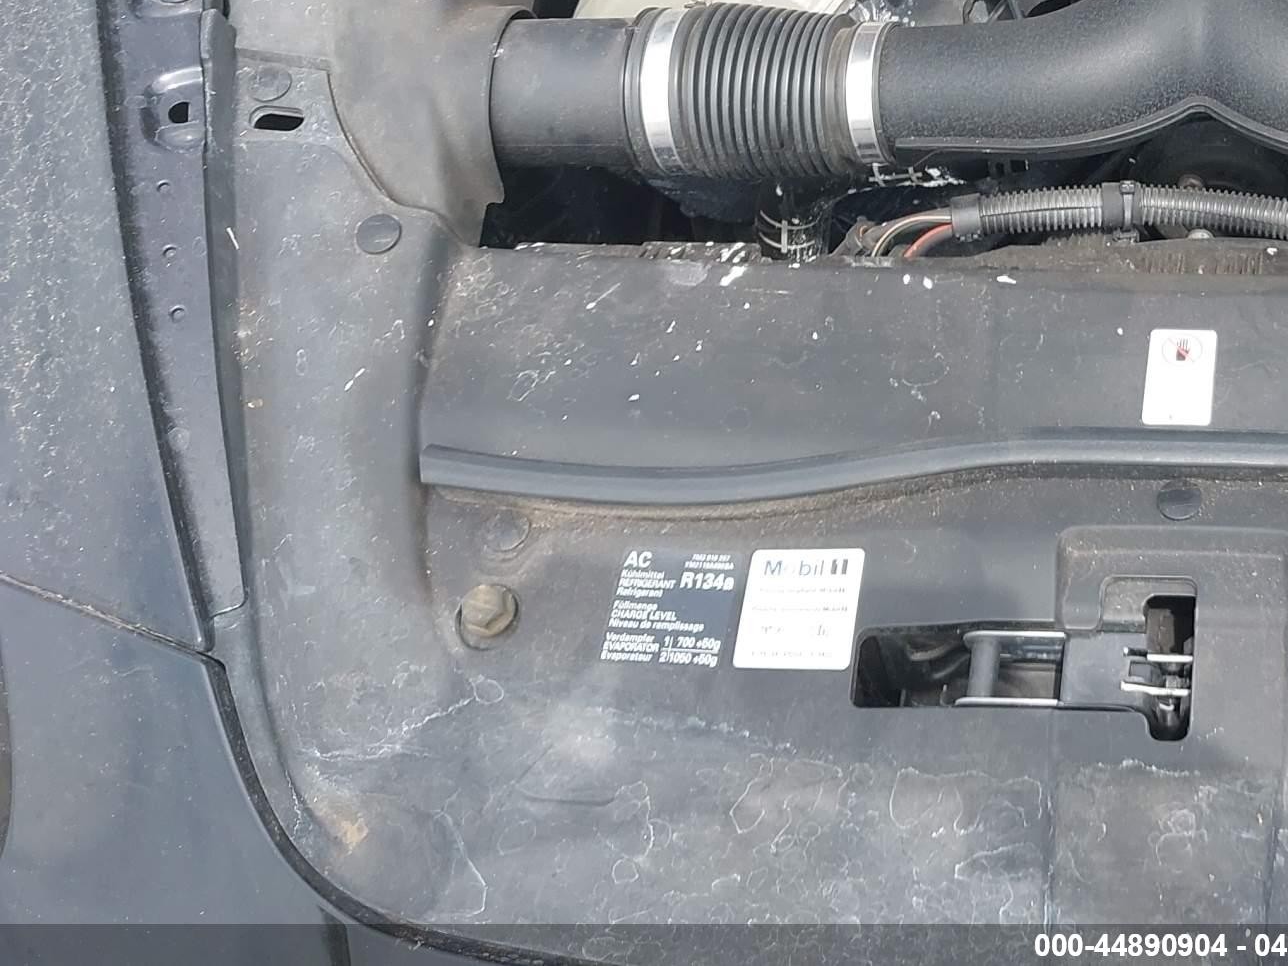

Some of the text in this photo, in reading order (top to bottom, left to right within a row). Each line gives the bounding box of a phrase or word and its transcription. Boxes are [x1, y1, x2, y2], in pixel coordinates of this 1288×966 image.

[623, 550, 652, 568] AC
[764, 559, 825, 576] Mbil
[618, 578, 677, 589] REFRIGERANT
[611, 609, 677, 621] CHARGE LEVEL
[608, 618, 705, 633] Niveau de remplissage
[603, 641, 660, 652] EVAPORATOR
[677, 636, 696, 648] 700
